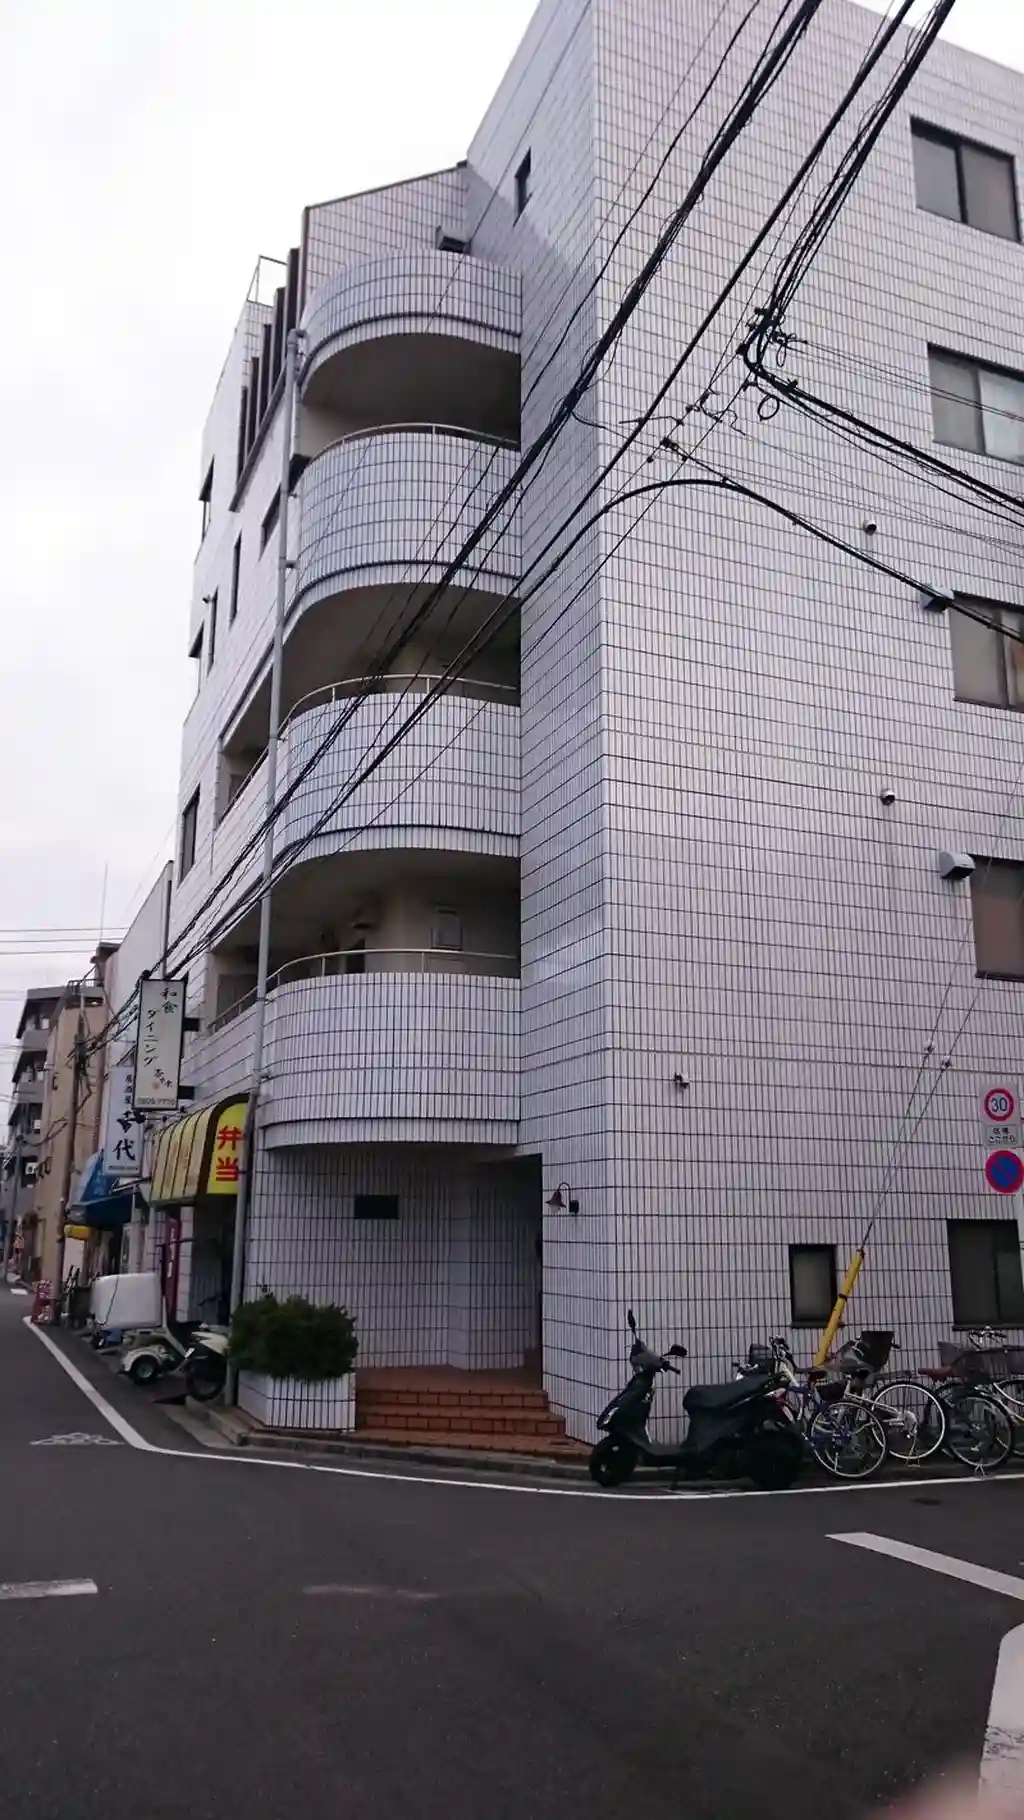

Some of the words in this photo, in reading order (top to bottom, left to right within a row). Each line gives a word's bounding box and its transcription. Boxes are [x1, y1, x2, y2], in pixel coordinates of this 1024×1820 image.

[160, 987, 178, 1014] 和食
[143, 1008, 161, 1067] ダイニング
[991, 1097, 1008, 1112] 30
[215, 1124, 243, 1181] 弁当
